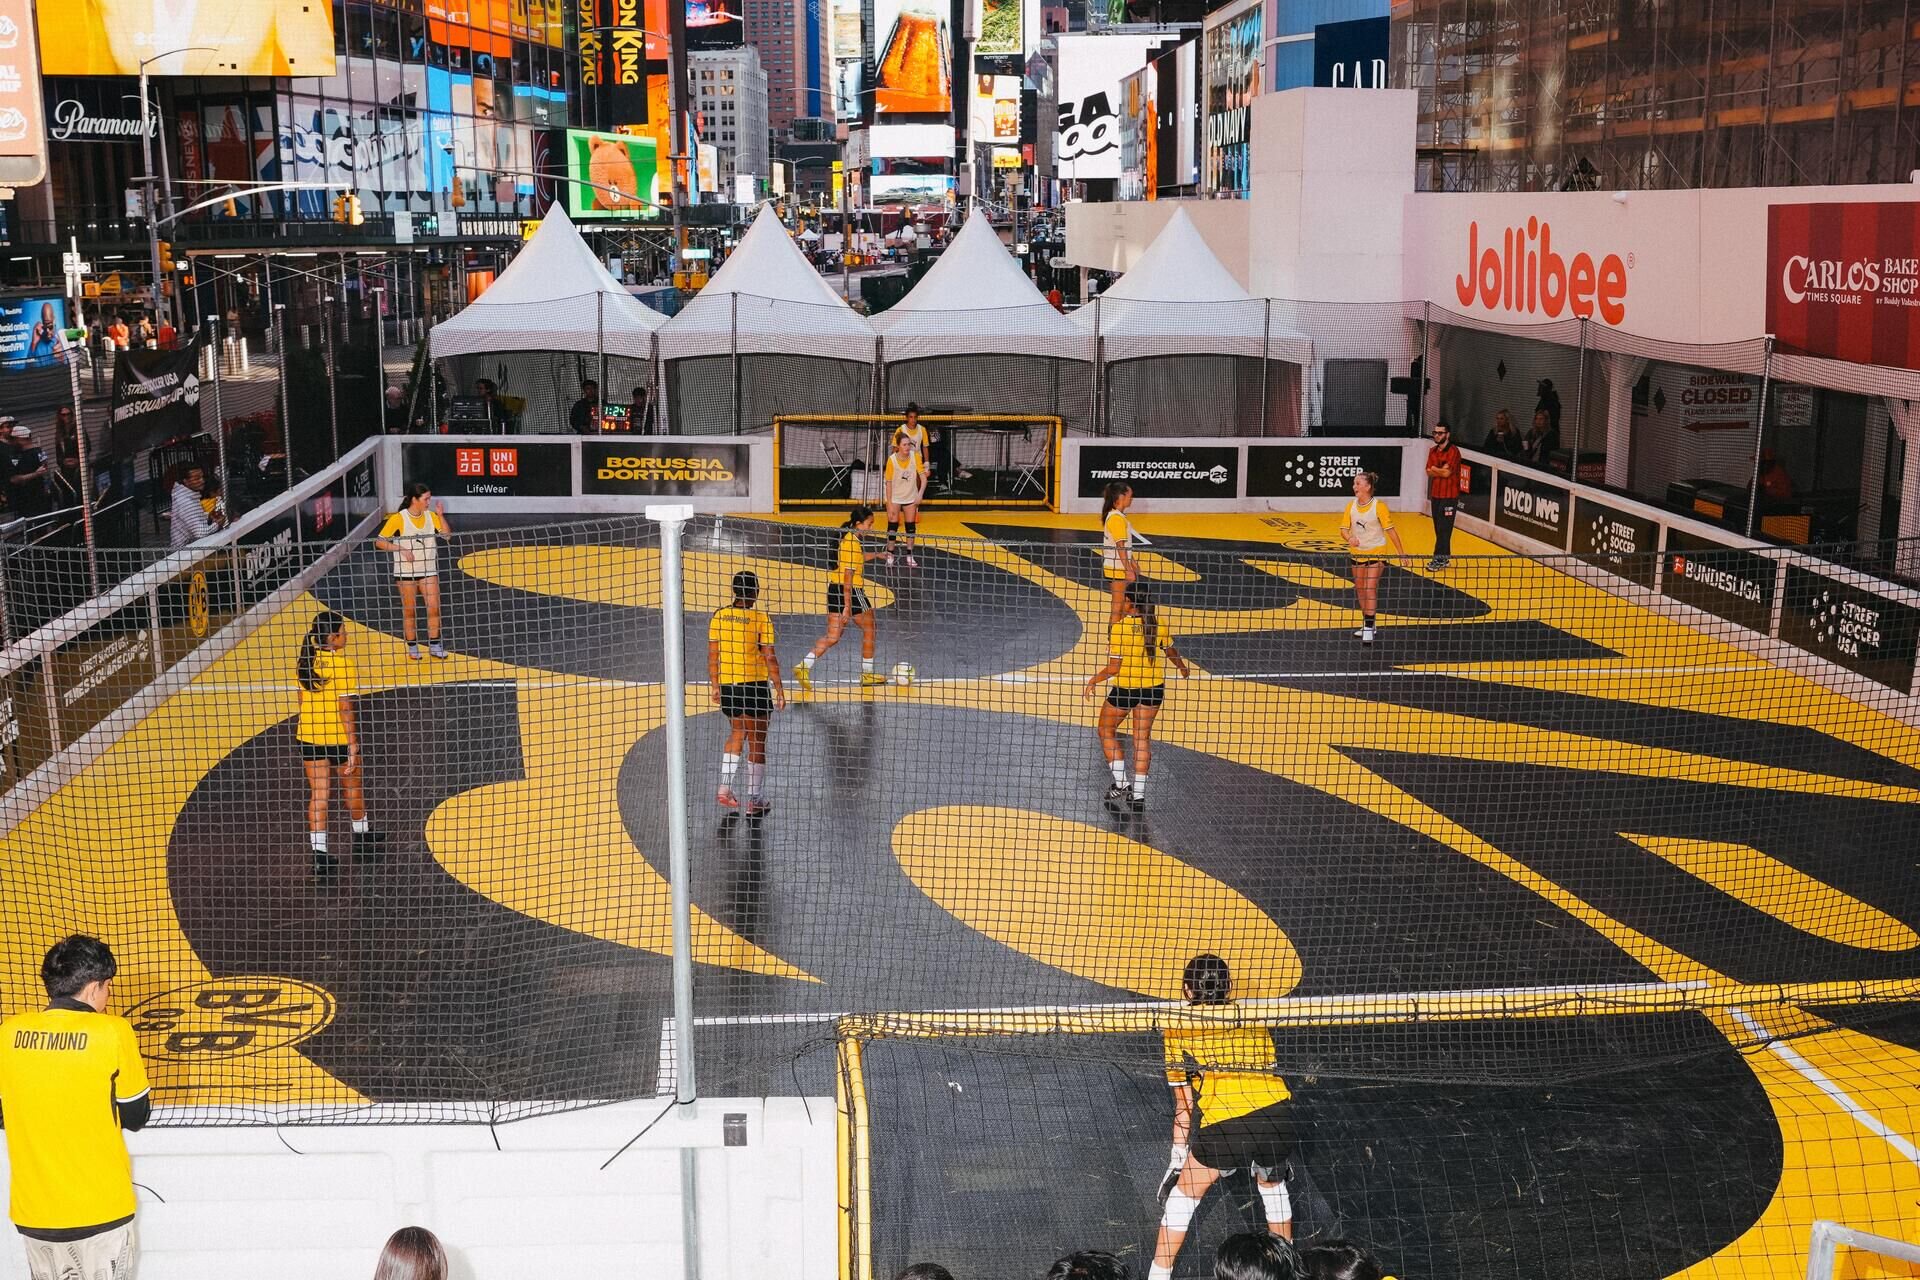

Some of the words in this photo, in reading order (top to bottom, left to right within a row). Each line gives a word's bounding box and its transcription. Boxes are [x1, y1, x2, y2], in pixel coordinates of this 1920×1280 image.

[613, 31, 643, 85] KING
[1208, 113, 1222, 147] OLD
[1223, 106, 1246, 145] NAVY
[1456, 215, 1627, 325] Jollibee
[1783, 255, 1880, 304] CARLO'S
[1884, 257, 1919, 275] BAKE
[1882, 277, 1919, 294] SHOP
[1806, 292, 1829, 303] TIMES
[1831, 292, 1862, 305] SQUARE
[1690, 374, 1745, 386] SIDEWALK
[1681, 387, 1753, 405] CLOSED
[604, 406, 626, 417] 1:24
[460, 451, 481, 462] ユニ
[492, 451, 513, 462] UNI
[606, 457, 724, 469] BORUSSIA
[1319, 456, 1360, 466] STREET
[460, 462, 481, 473] クロ
[493, 462, 514, 474] QLO
[1116, 461, 1145, 469] STREET
[1179, 462, 1195, 470] USA
[597, 469, 733, 481] DORTMUND
[1090, 470, 1129, 479] TIMES
[1130, 470, 1182, 480] SQUARE
[1183, 471, 1210, 480] CUP
[466, 484, 508, 493] LifeWear
[1318, 478, 1342, 488] USA
[1504, 487, 1532, 514] DYCD
[1535, 497, 1560, 523] NYC
[1611, 522, 1635, 539] STREET
[1610, 536, 1636, 555] SOCCER
[1685, 560, 1761, 603] BUNDESLIGA
[1841, 600, 1880, 628] STREET
[1838, 618, 1880, 648] SOCCER
[1837, 636, 1859, 658] USA
[14, 1030, 88, 1051] DORTMUND
